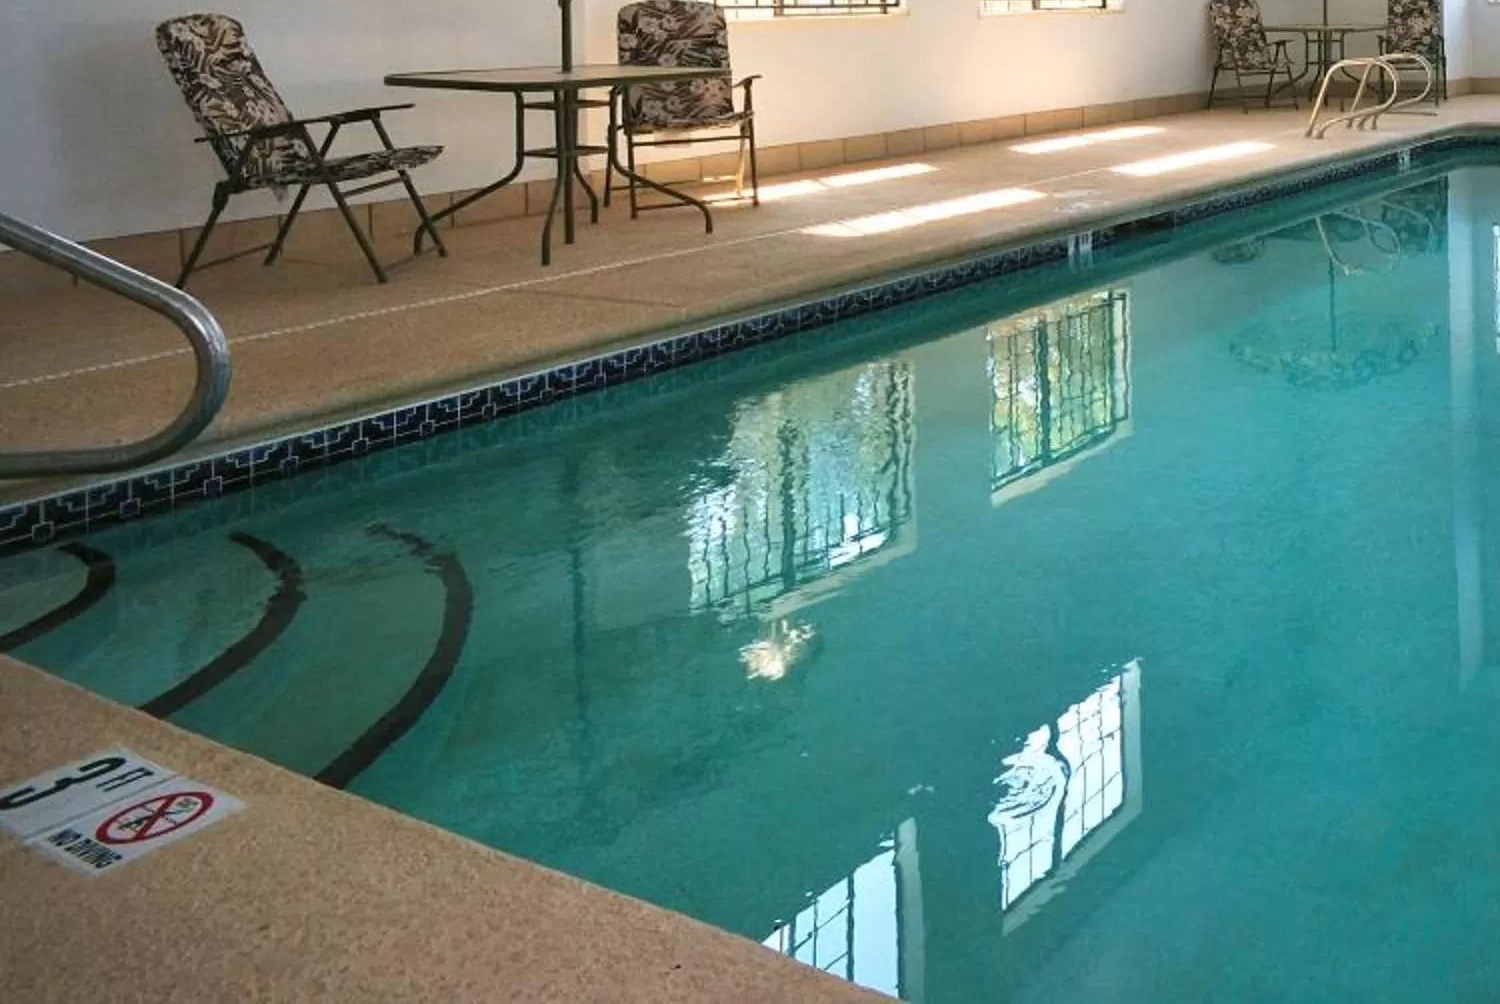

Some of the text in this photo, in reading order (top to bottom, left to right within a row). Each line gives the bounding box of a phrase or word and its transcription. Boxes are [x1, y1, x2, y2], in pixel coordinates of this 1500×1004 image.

[0, 757, 154, 810] 3 FT
[49, 829, 122, 868] NO DIVING
